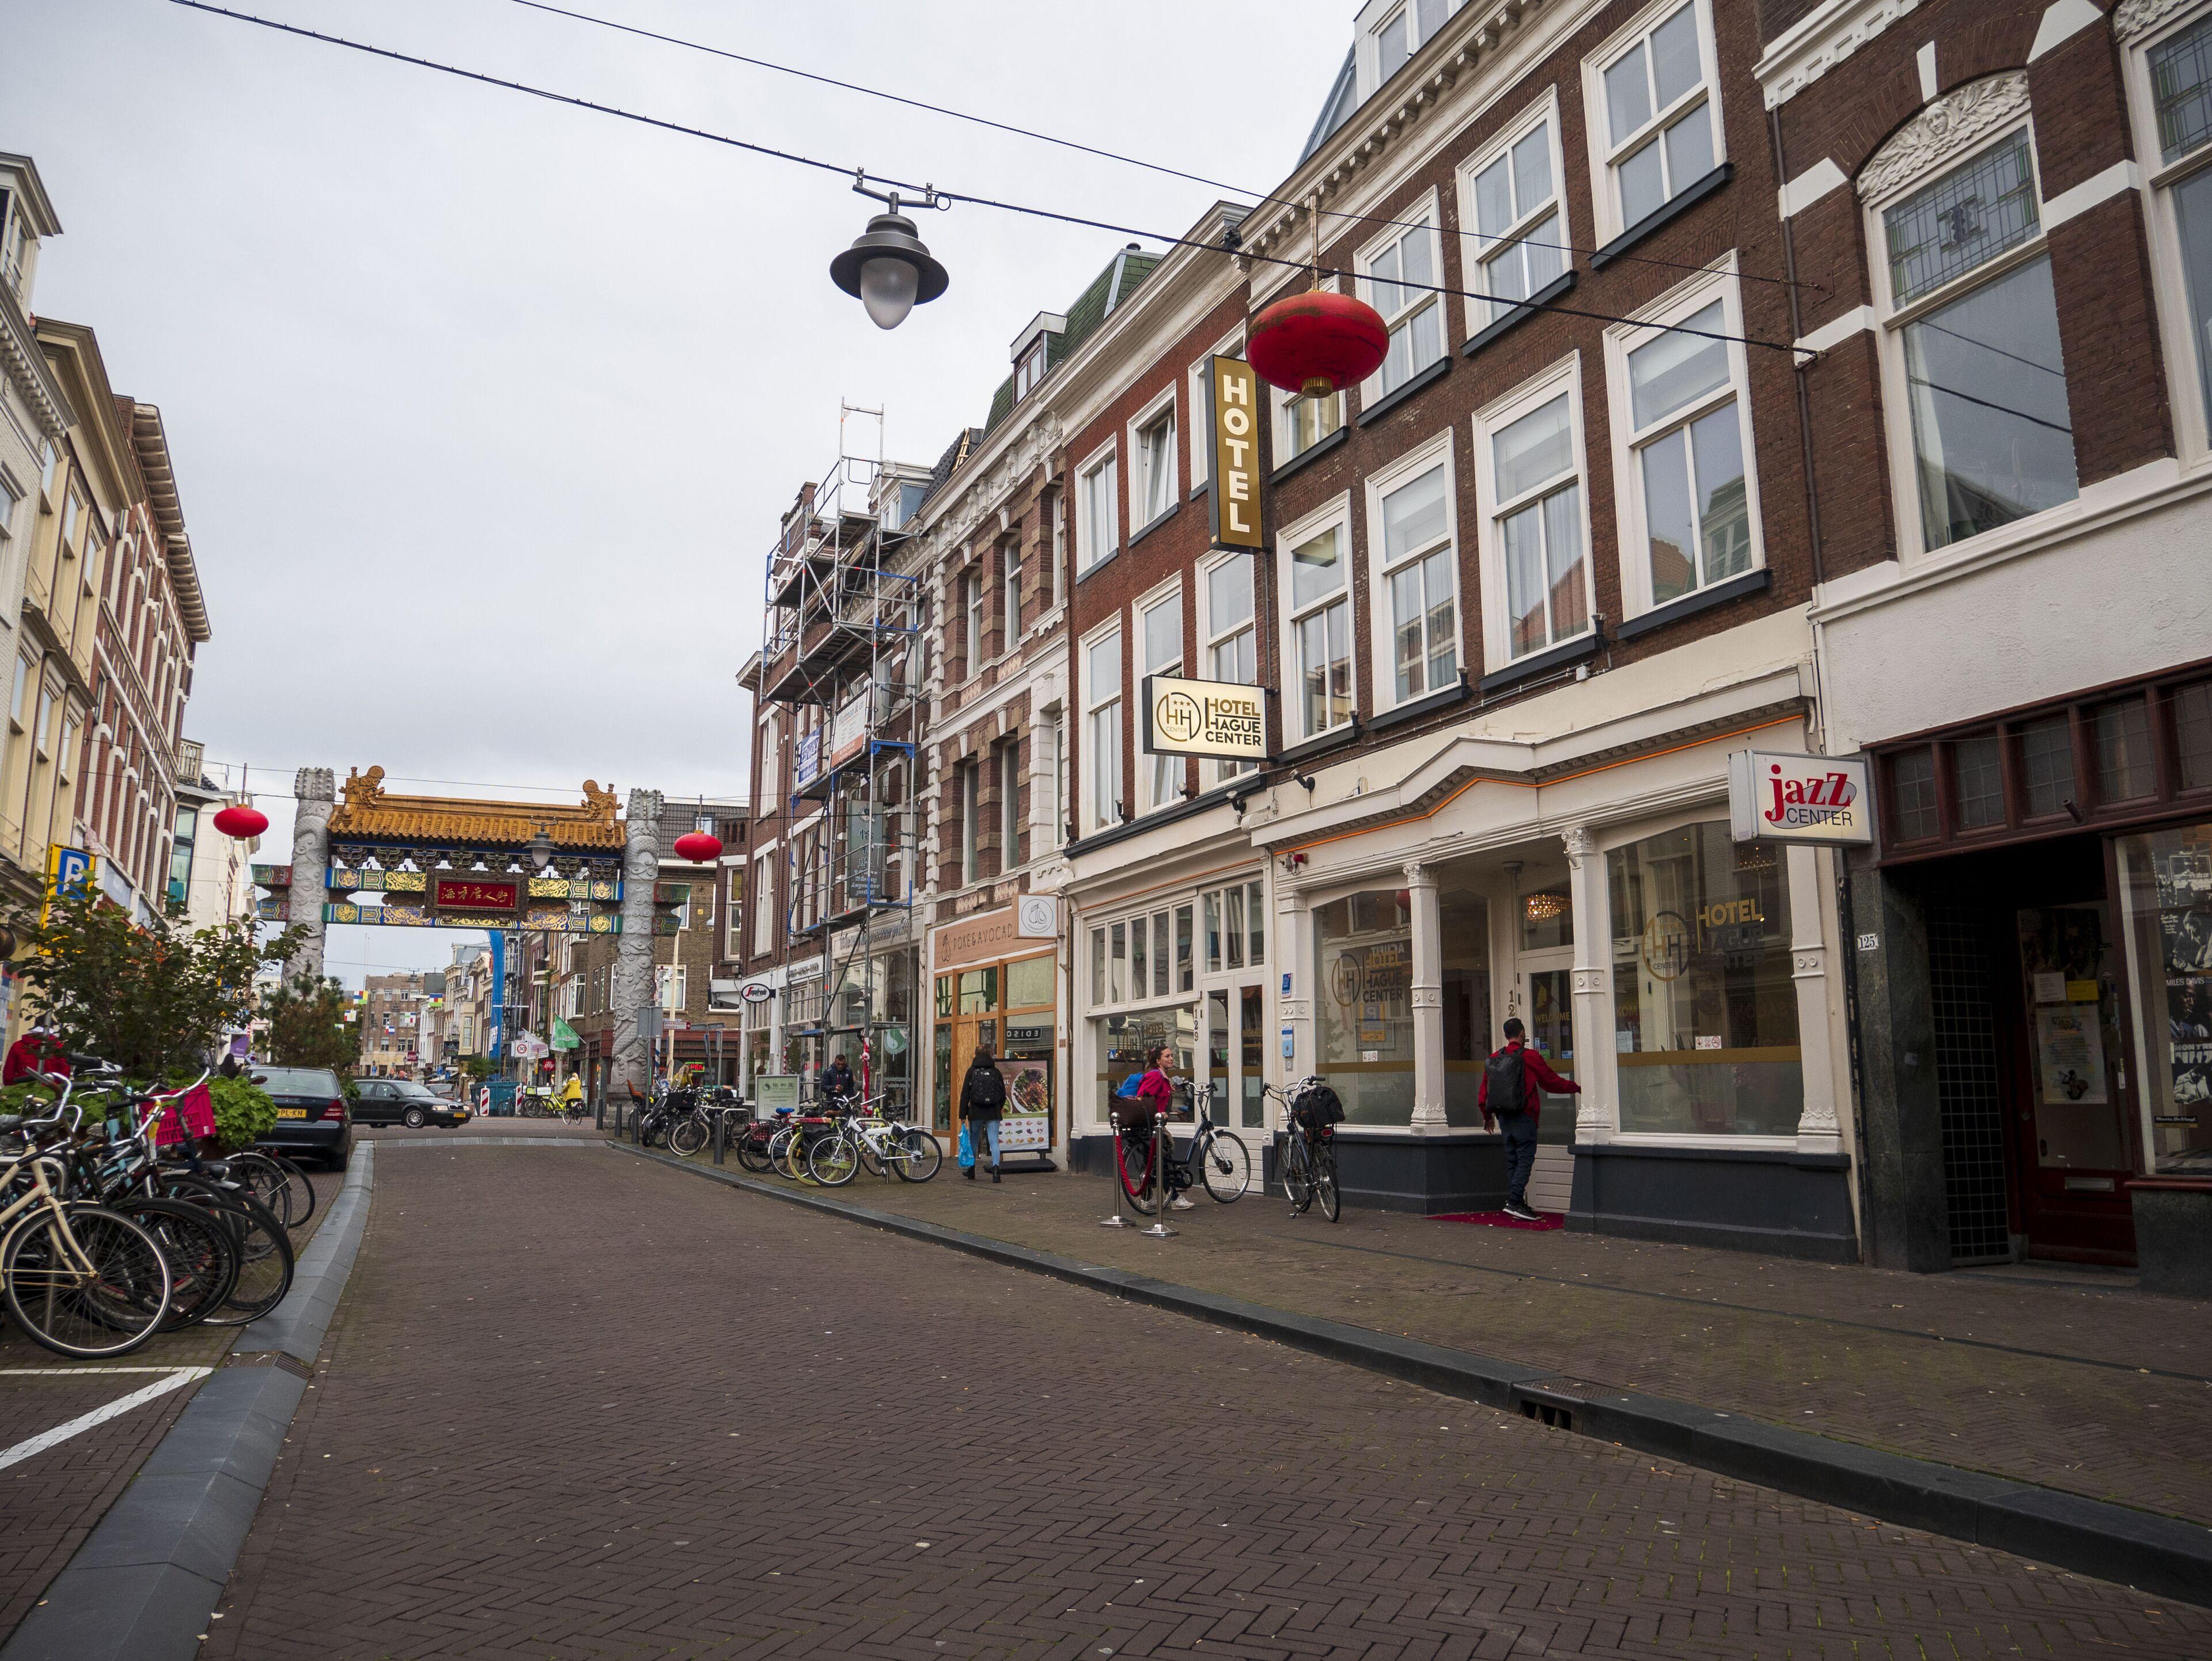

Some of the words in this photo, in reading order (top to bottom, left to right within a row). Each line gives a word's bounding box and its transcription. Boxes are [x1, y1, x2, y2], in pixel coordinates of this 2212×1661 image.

[1222, 374, 1249, 533] HOTEL
[1205, 697, 1260, 717] HOTEL
[1206, 718, 1260, 733] HAGUE
[1205, 731, 1261, 746] CENTER
[1786, 808, 1853, 826] CENTER
[63, 856, 84, 892] P
[1696, 899, 1763, 928] HOTEL
[954, 924, 1012, 951] POKE&AVOCAD
[1859, 936, 1875, 949] 125
[1653, 962, 1677, 970] CENTER
[2187, 977, 2205, 985] DAVIS
[1363, 987, 1403, 1002] CENTER
[544, 1061, 554, 1069] illy
